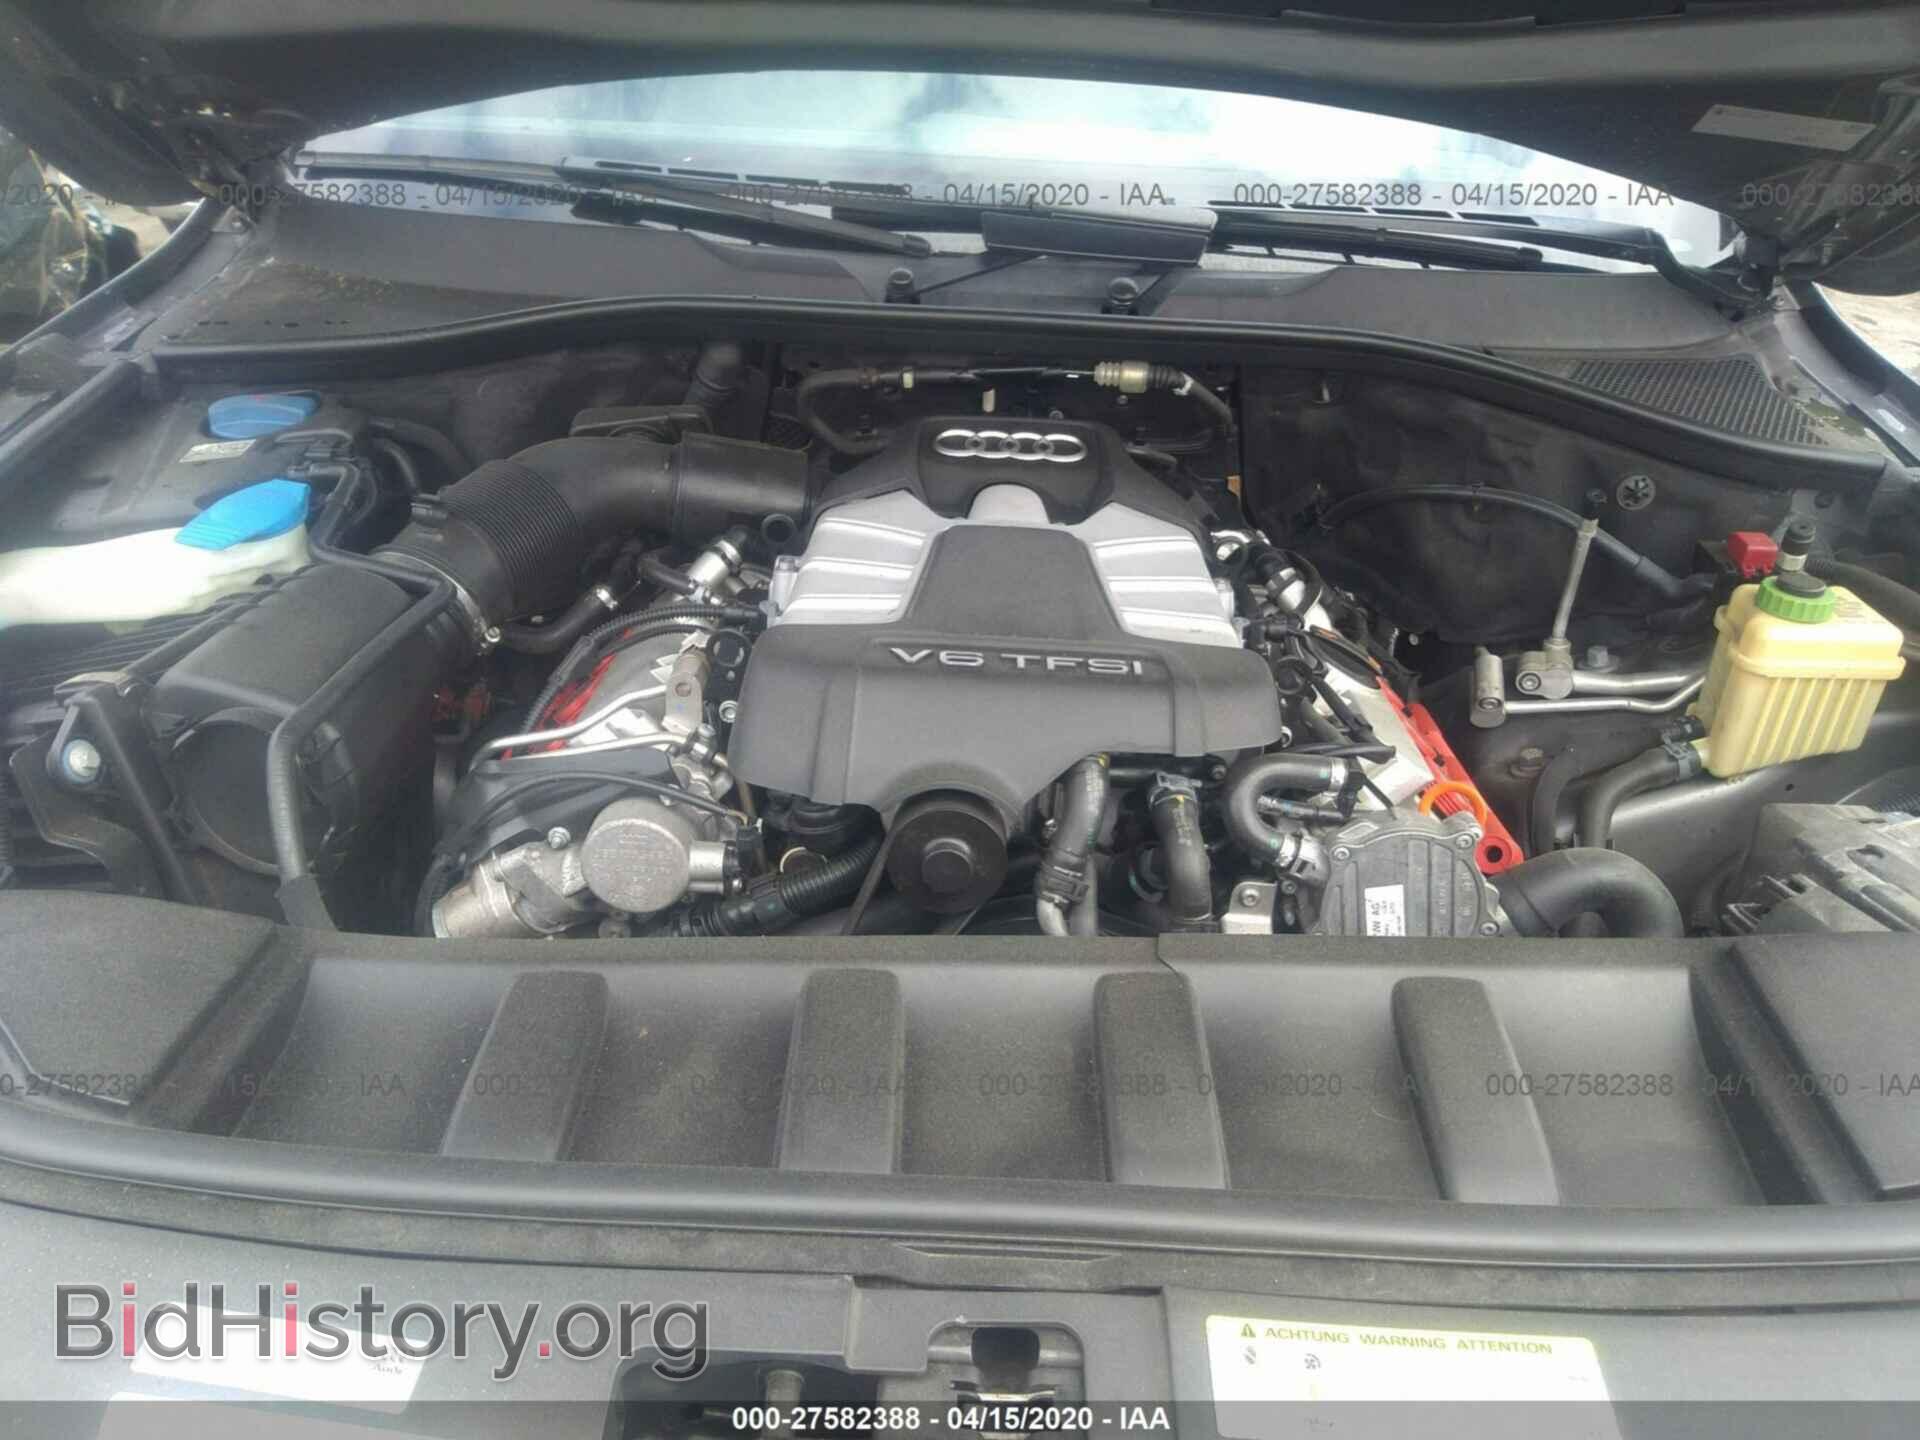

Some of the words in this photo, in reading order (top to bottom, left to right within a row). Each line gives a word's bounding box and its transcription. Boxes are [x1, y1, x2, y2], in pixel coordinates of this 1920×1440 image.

[891, 647, 984, 666] V6
[1000, 653, 1143, 675] TFSI
[1264, 1327, 1349, 1343] ACHTUNG
[1359, 1333, 1447, 1349] WARNING
[1456, 1338, 1553, 1354] ATTENTION
